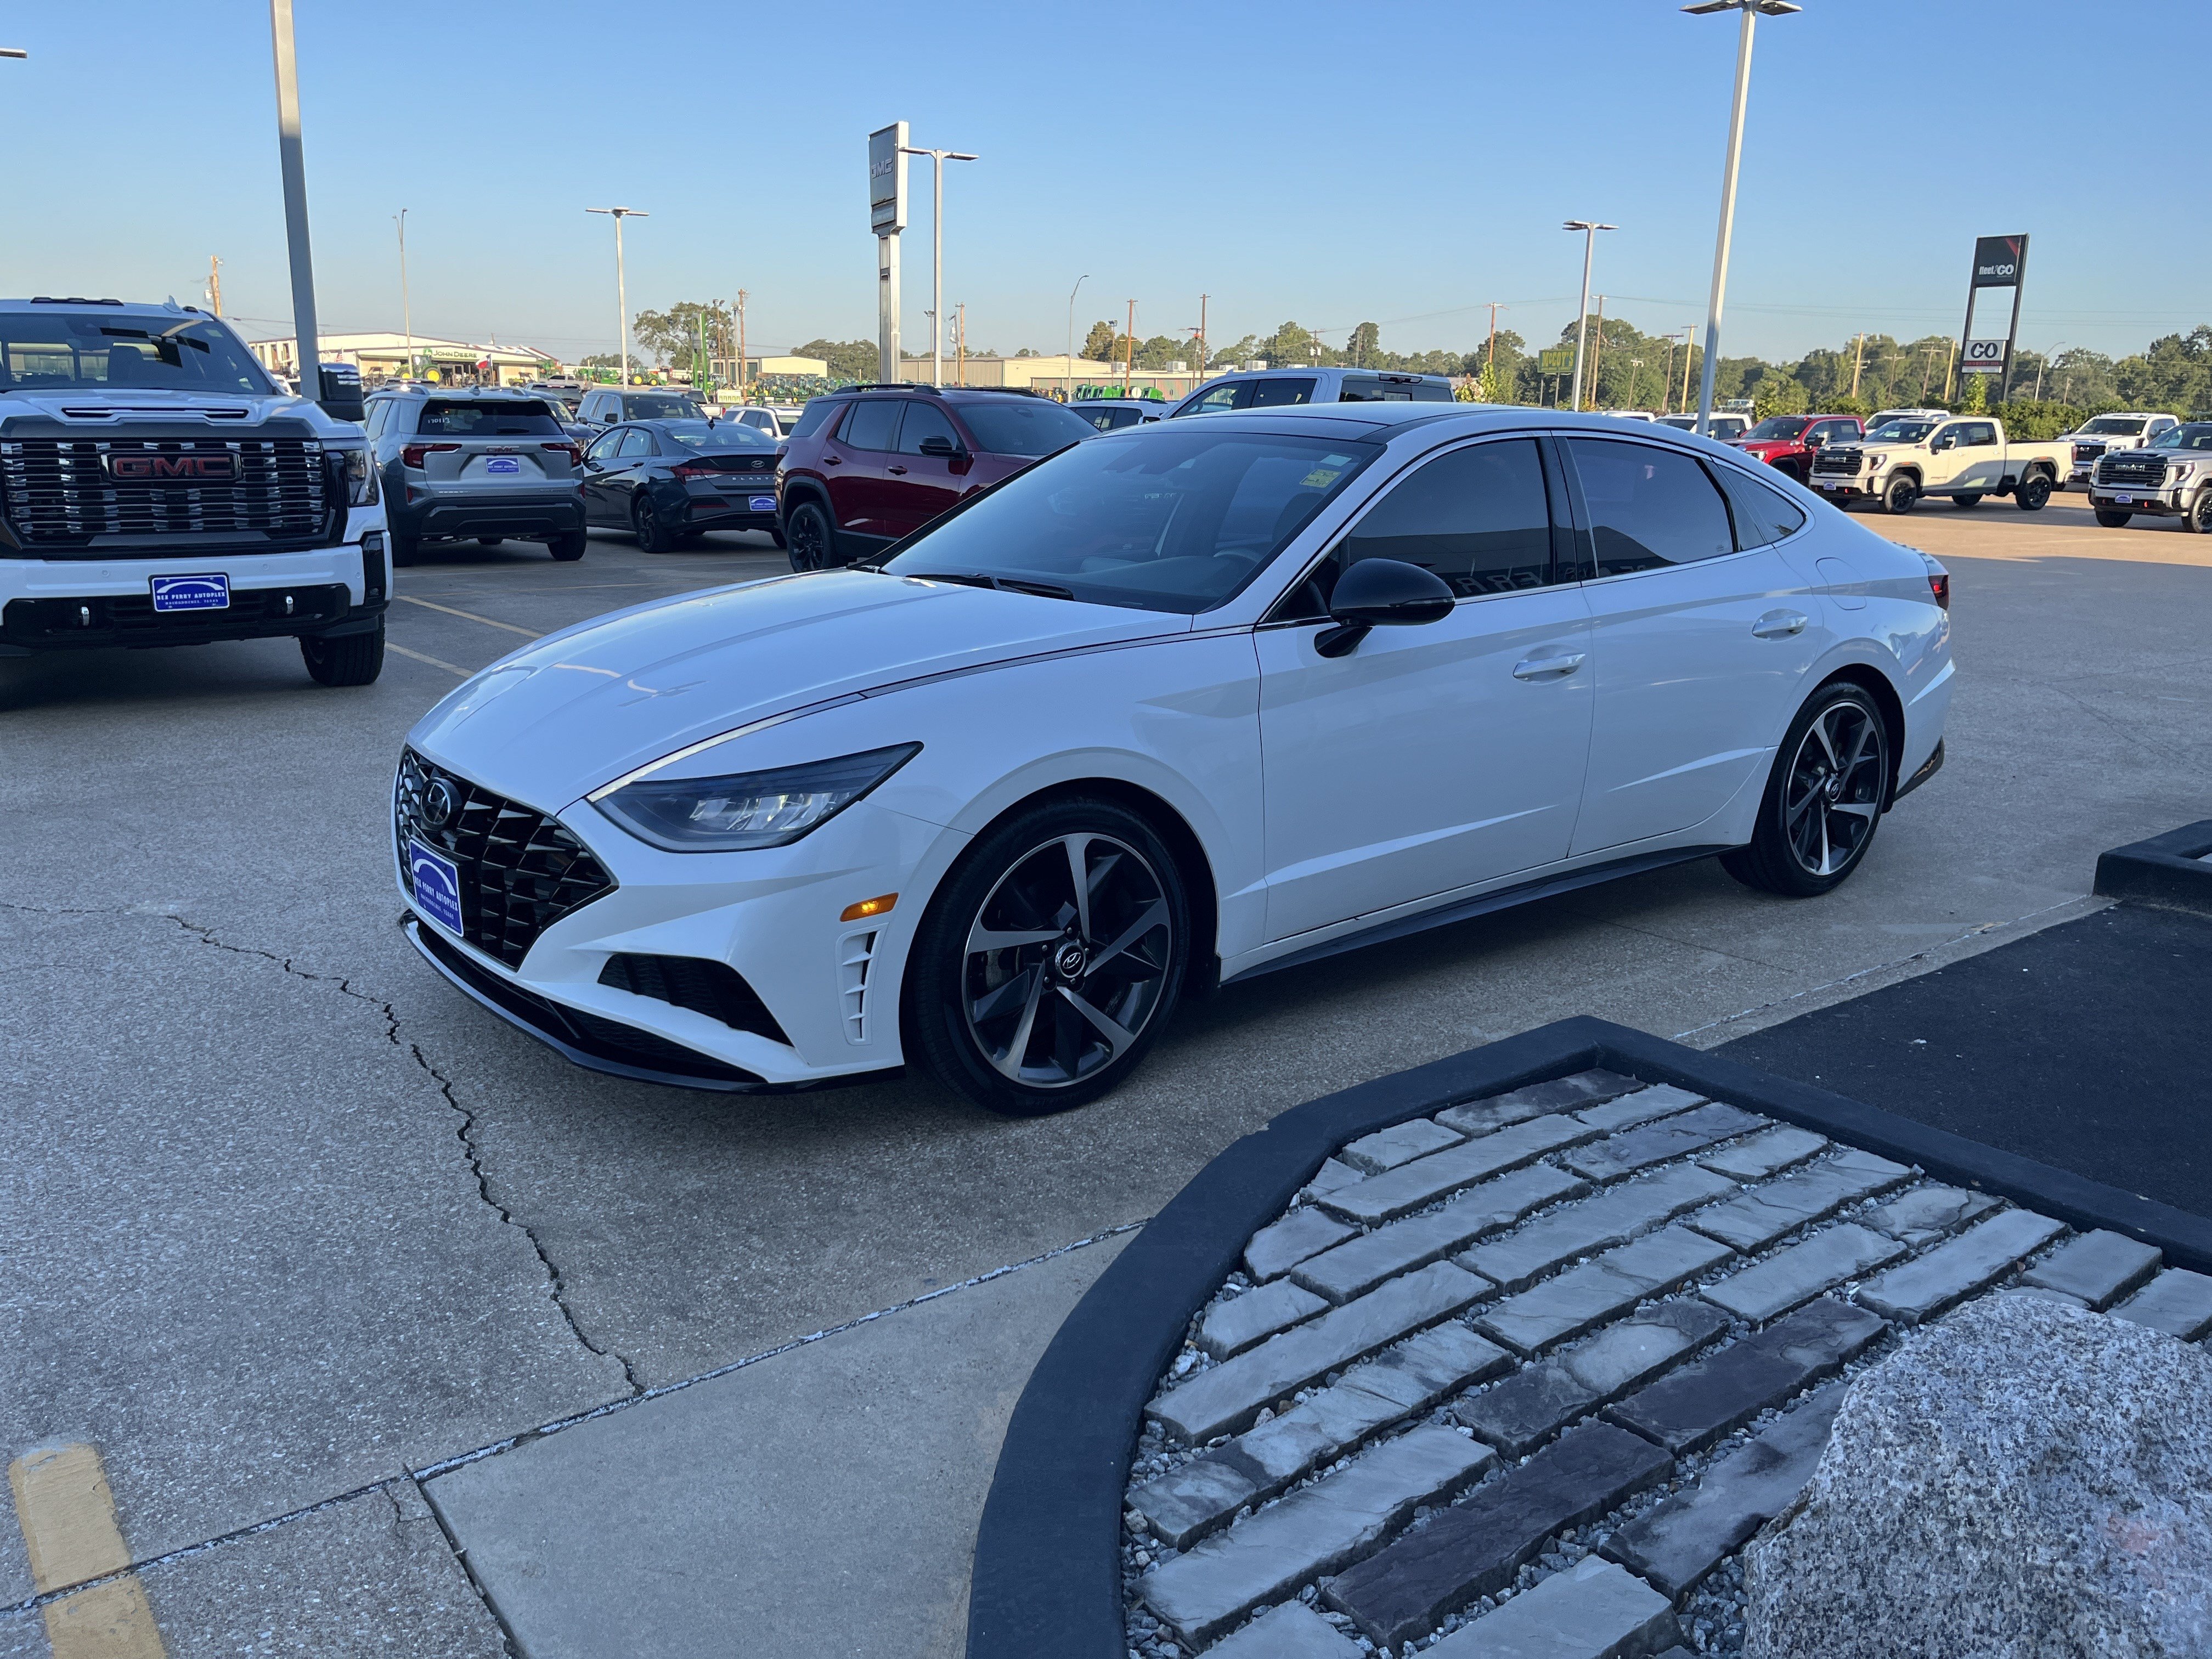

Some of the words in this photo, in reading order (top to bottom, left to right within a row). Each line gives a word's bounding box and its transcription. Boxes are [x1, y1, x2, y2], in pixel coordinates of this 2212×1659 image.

[871, 157, 893, 179] GMC
[1971, 342, 1998, 358] GO
[114, 457, 231, 476] GMC
[422, 881, 435, 897] PERRY
[436, 891, 458, 911] AUTOPLEX
